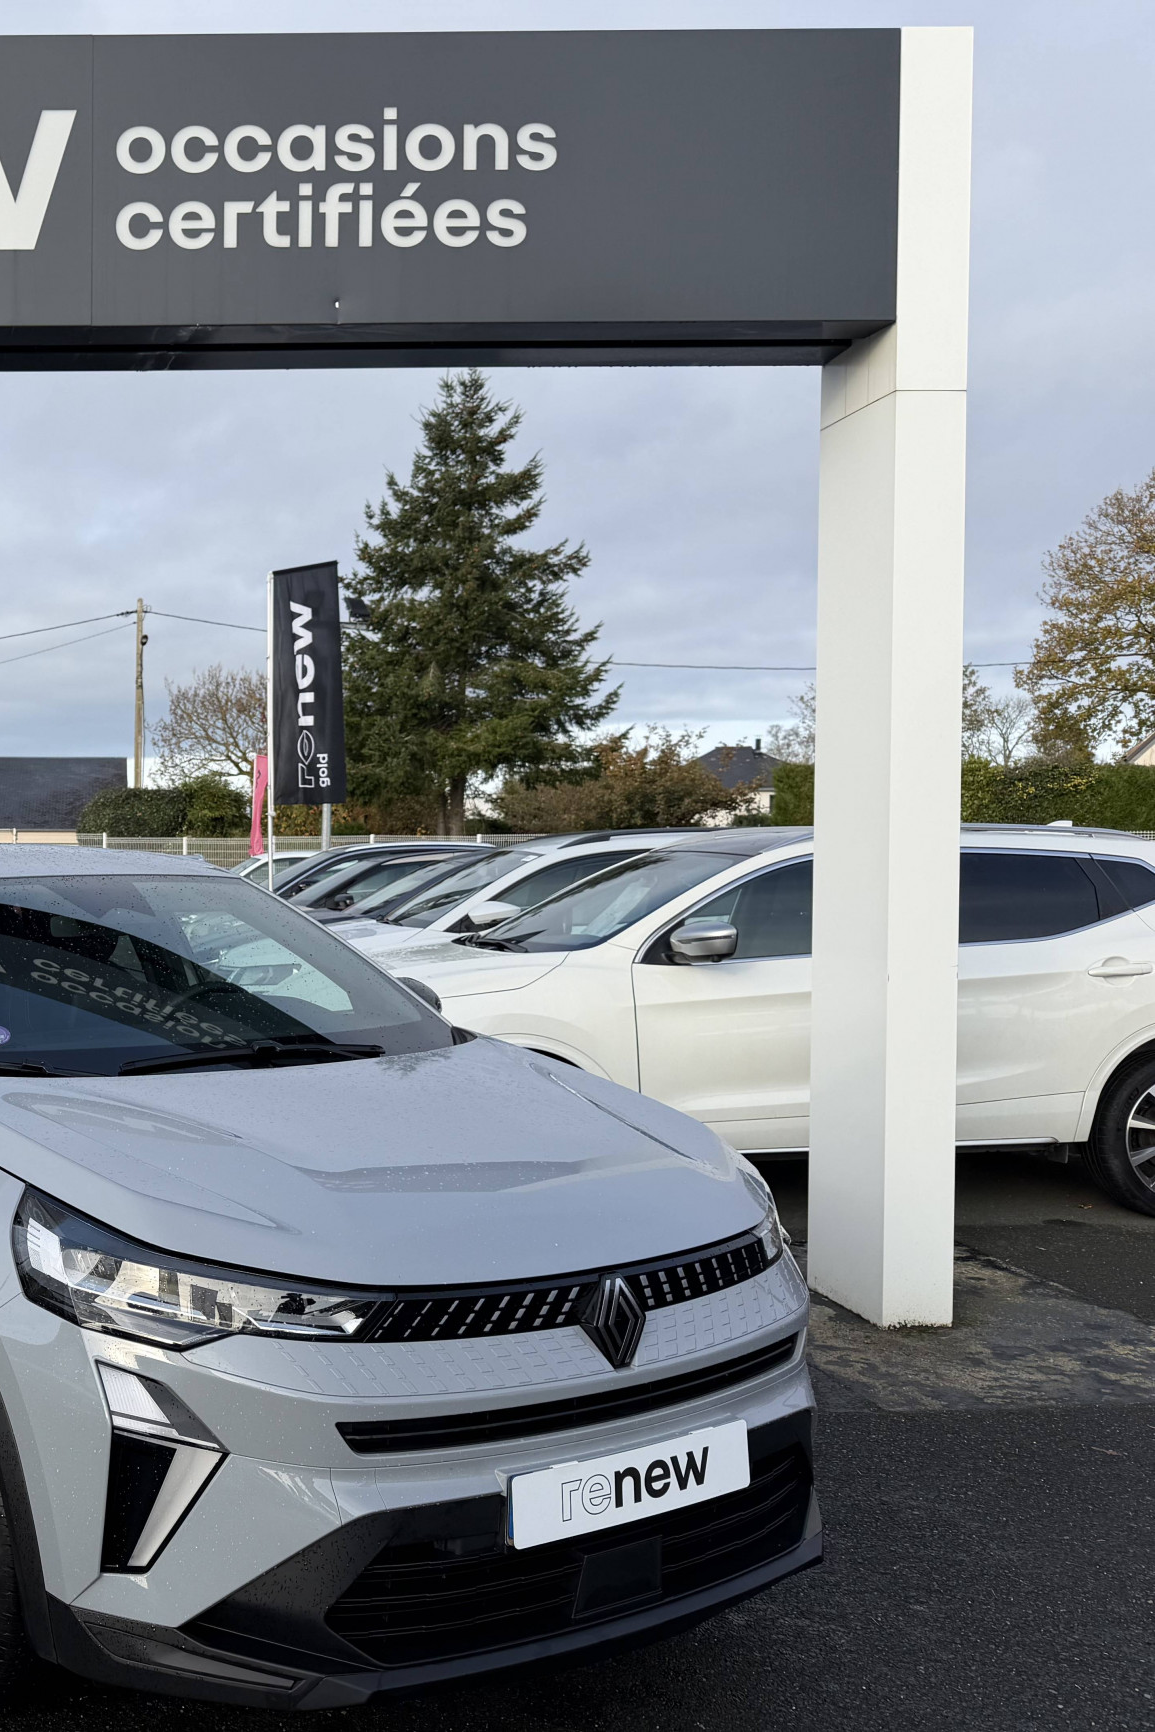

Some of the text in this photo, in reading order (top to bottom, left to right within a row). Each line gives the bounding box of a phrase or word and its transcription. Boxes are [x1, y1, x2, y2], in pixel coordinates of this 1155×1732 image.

[116, 107, 557, 174] occasions
[115, 182, 527, 250] certifiées
[289, 601, 316, 788] renew
[316, 753, 331, 788] gold
[561, 1446, 709, 1522] renew
